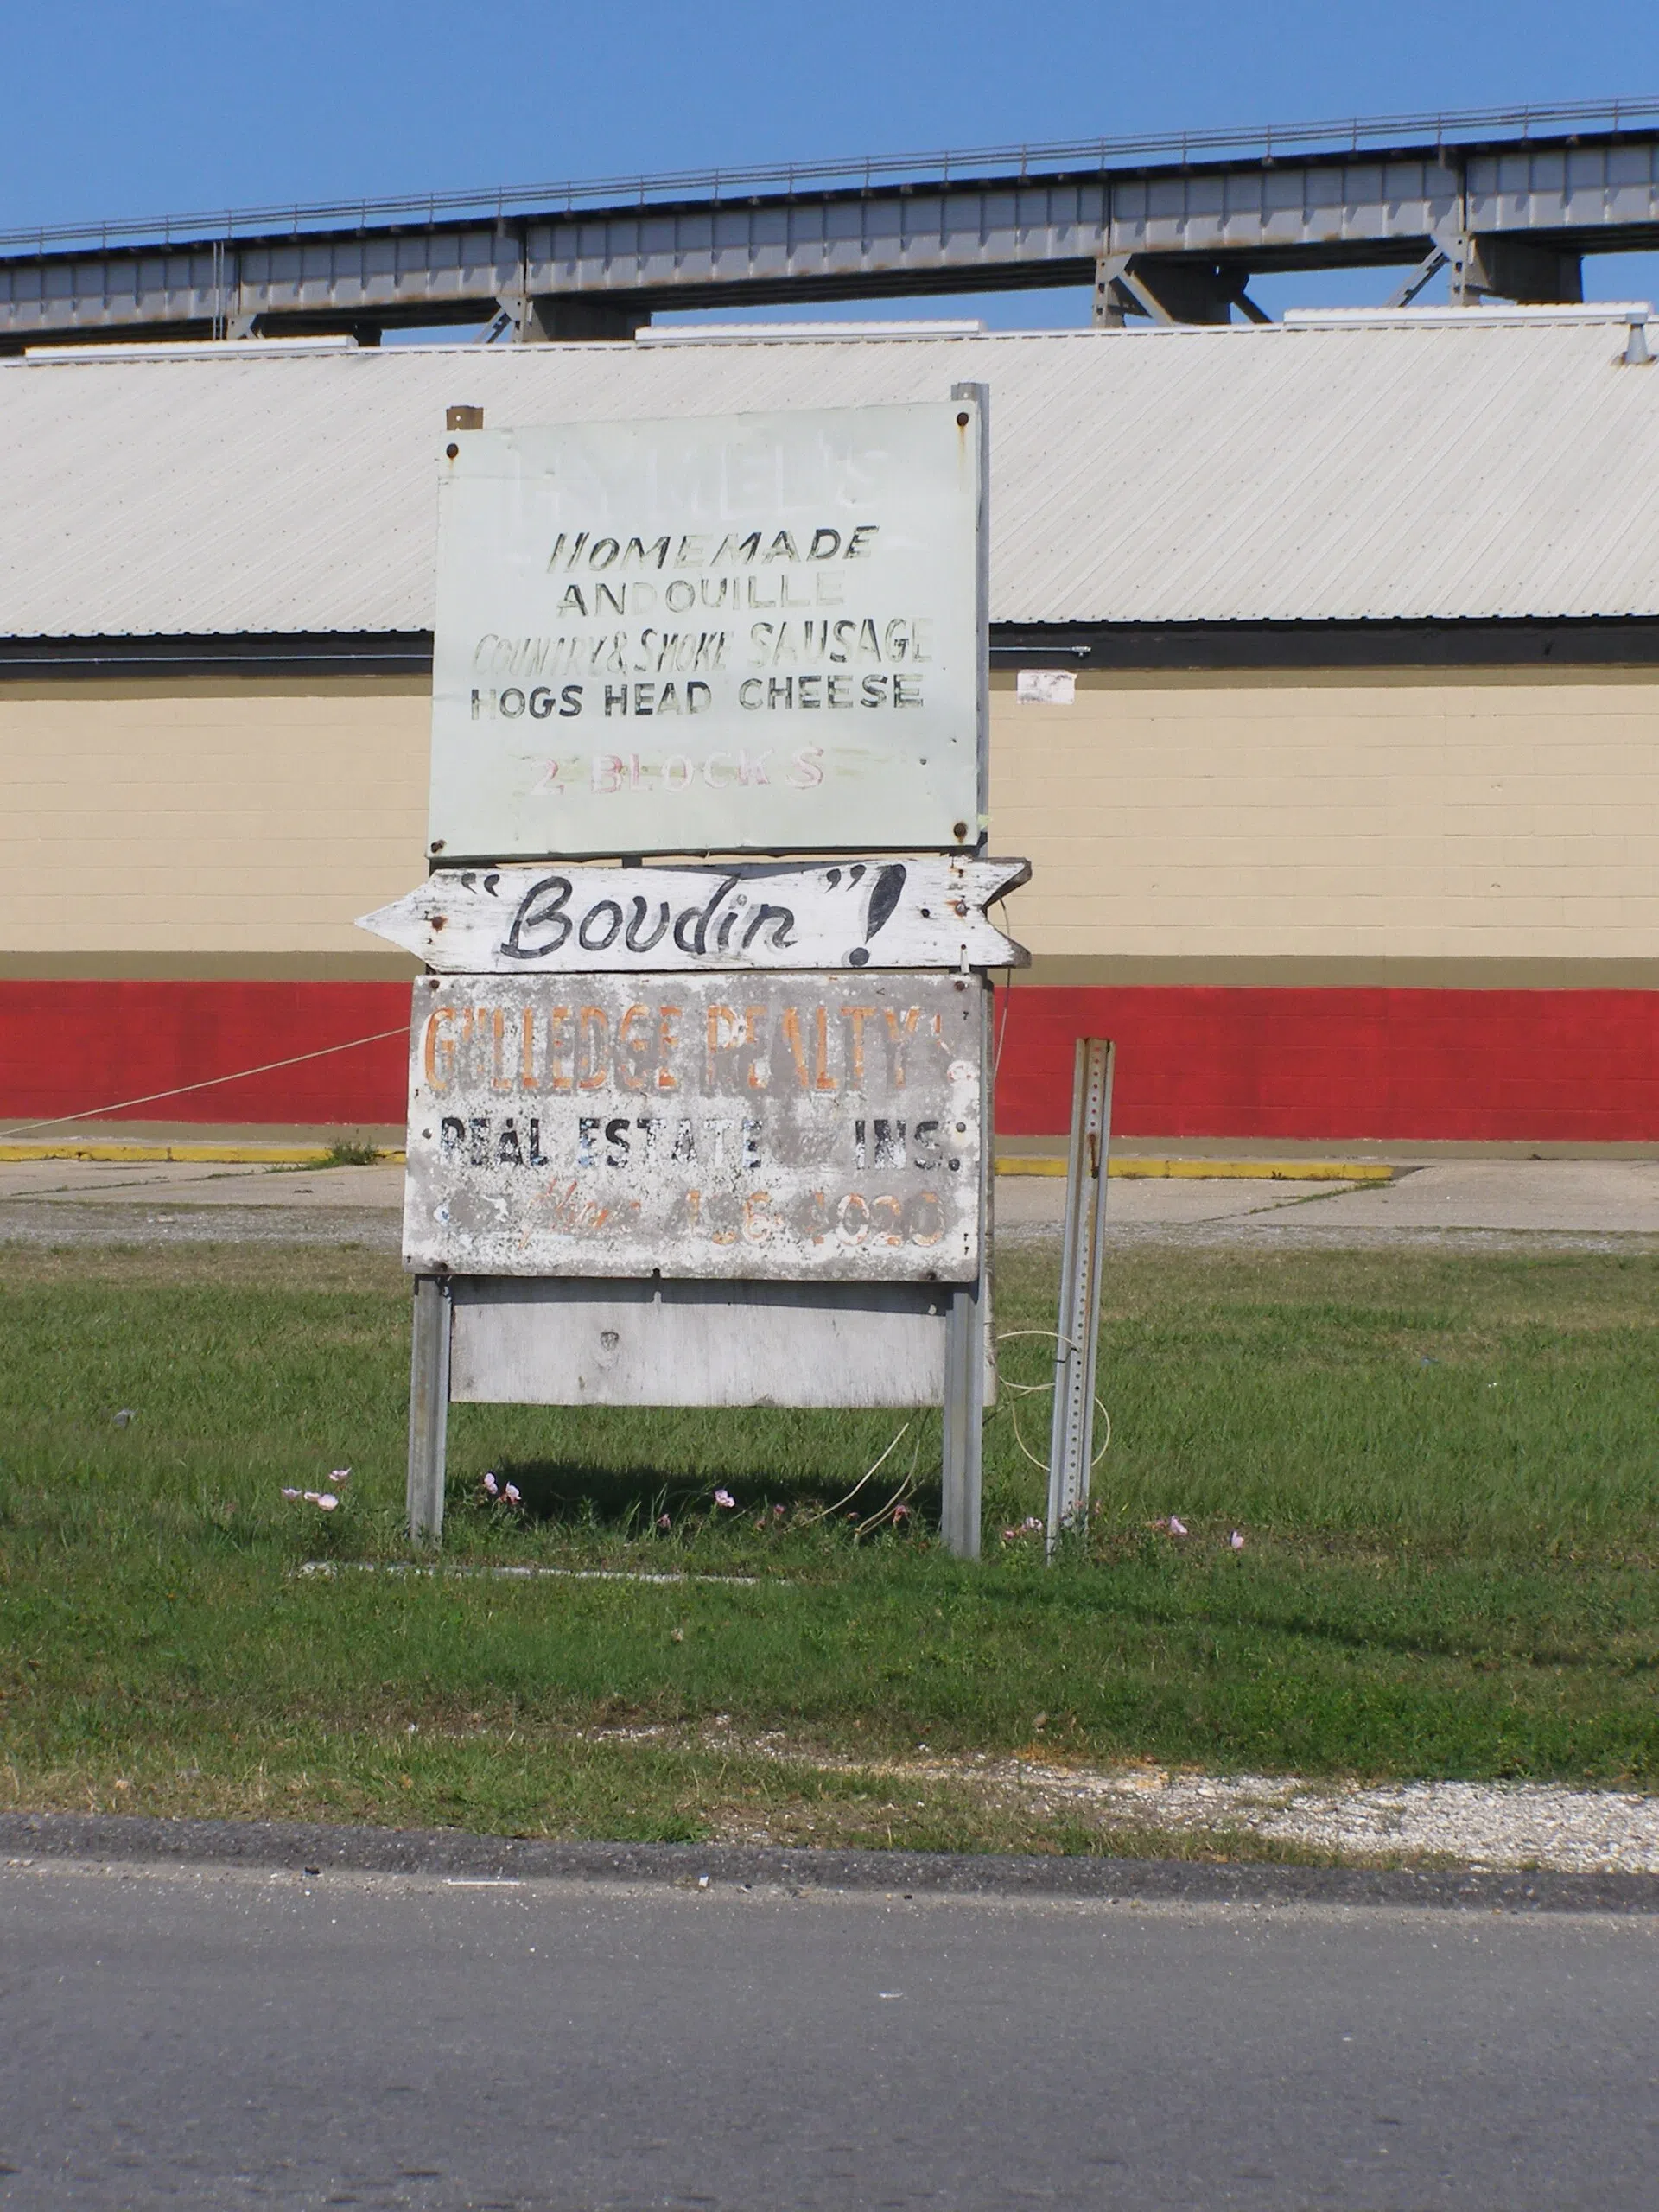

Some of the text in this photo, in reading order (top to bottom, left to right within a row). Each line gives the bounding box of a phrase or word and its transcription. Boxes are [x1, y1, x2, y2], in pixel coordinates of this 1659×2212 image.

[547, 525, 880, 574] HOMEMADE
[556, 570, 846, 617] ANDOUILLE
[747, 618, 933, 668] SAUSAGE
[471, 673, 924, 720] HOGS HEAD CHEESE
[530, 757, 565, 795] 2
[439, 1118, 548, 1166] REAL
[579, 1118, 761, 1167] ESTATE
